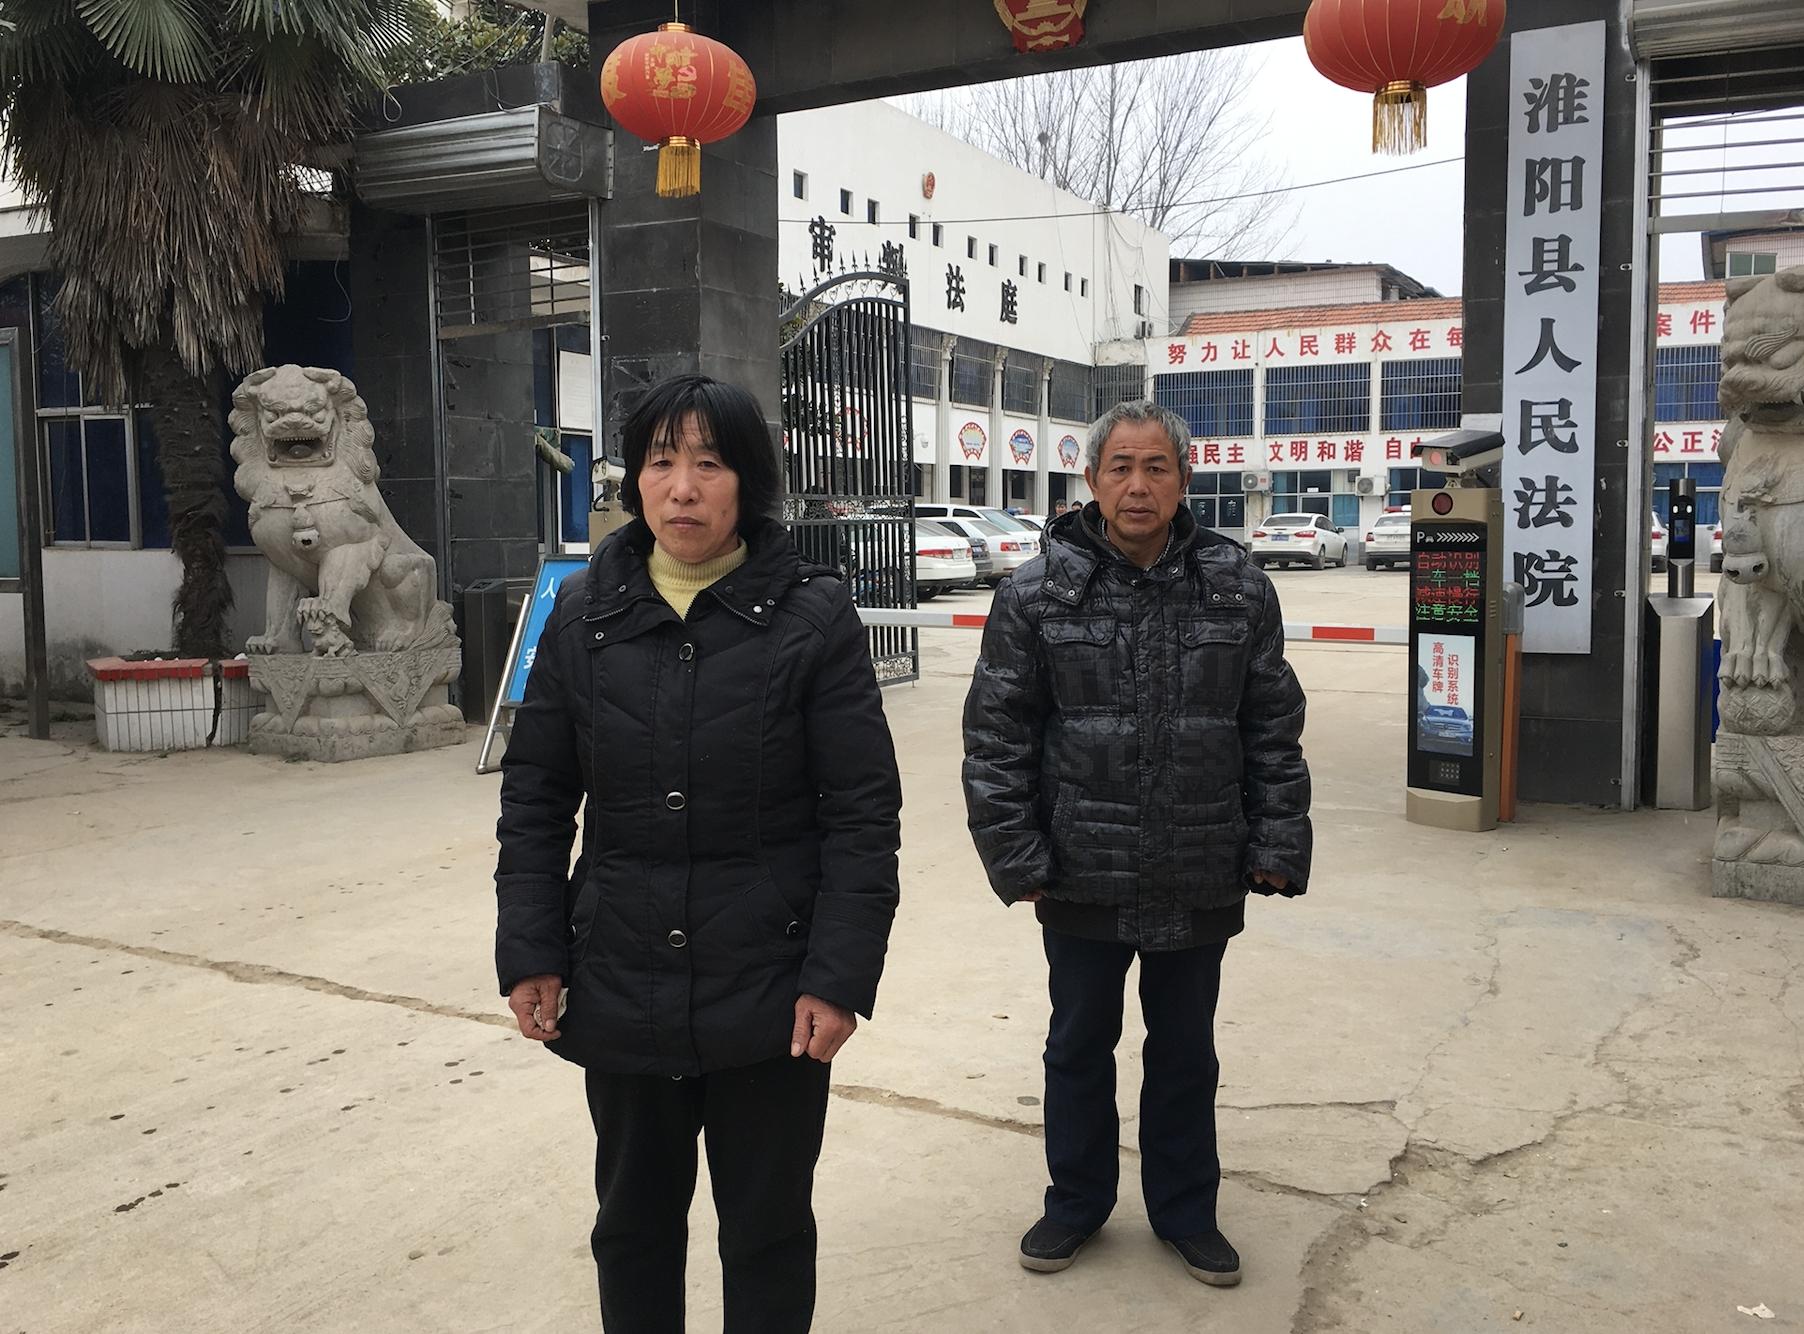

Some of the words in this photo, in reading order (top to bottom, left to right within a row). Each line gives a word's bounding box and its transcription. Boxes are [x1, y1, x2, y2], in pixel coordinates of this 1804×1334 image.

[1168, 326, 1463, 364] 努力让人民群众在每
[1513, 72, 1590, 608] 淮阳县人民法院
[1269, 440, 1365, 462] 文明和谐
[1415, 603, 1480, 622] 注意安全
[1432, 641, 1444, 693] 高清车牌
[1447, 653, 1459, 705] 识别系统
